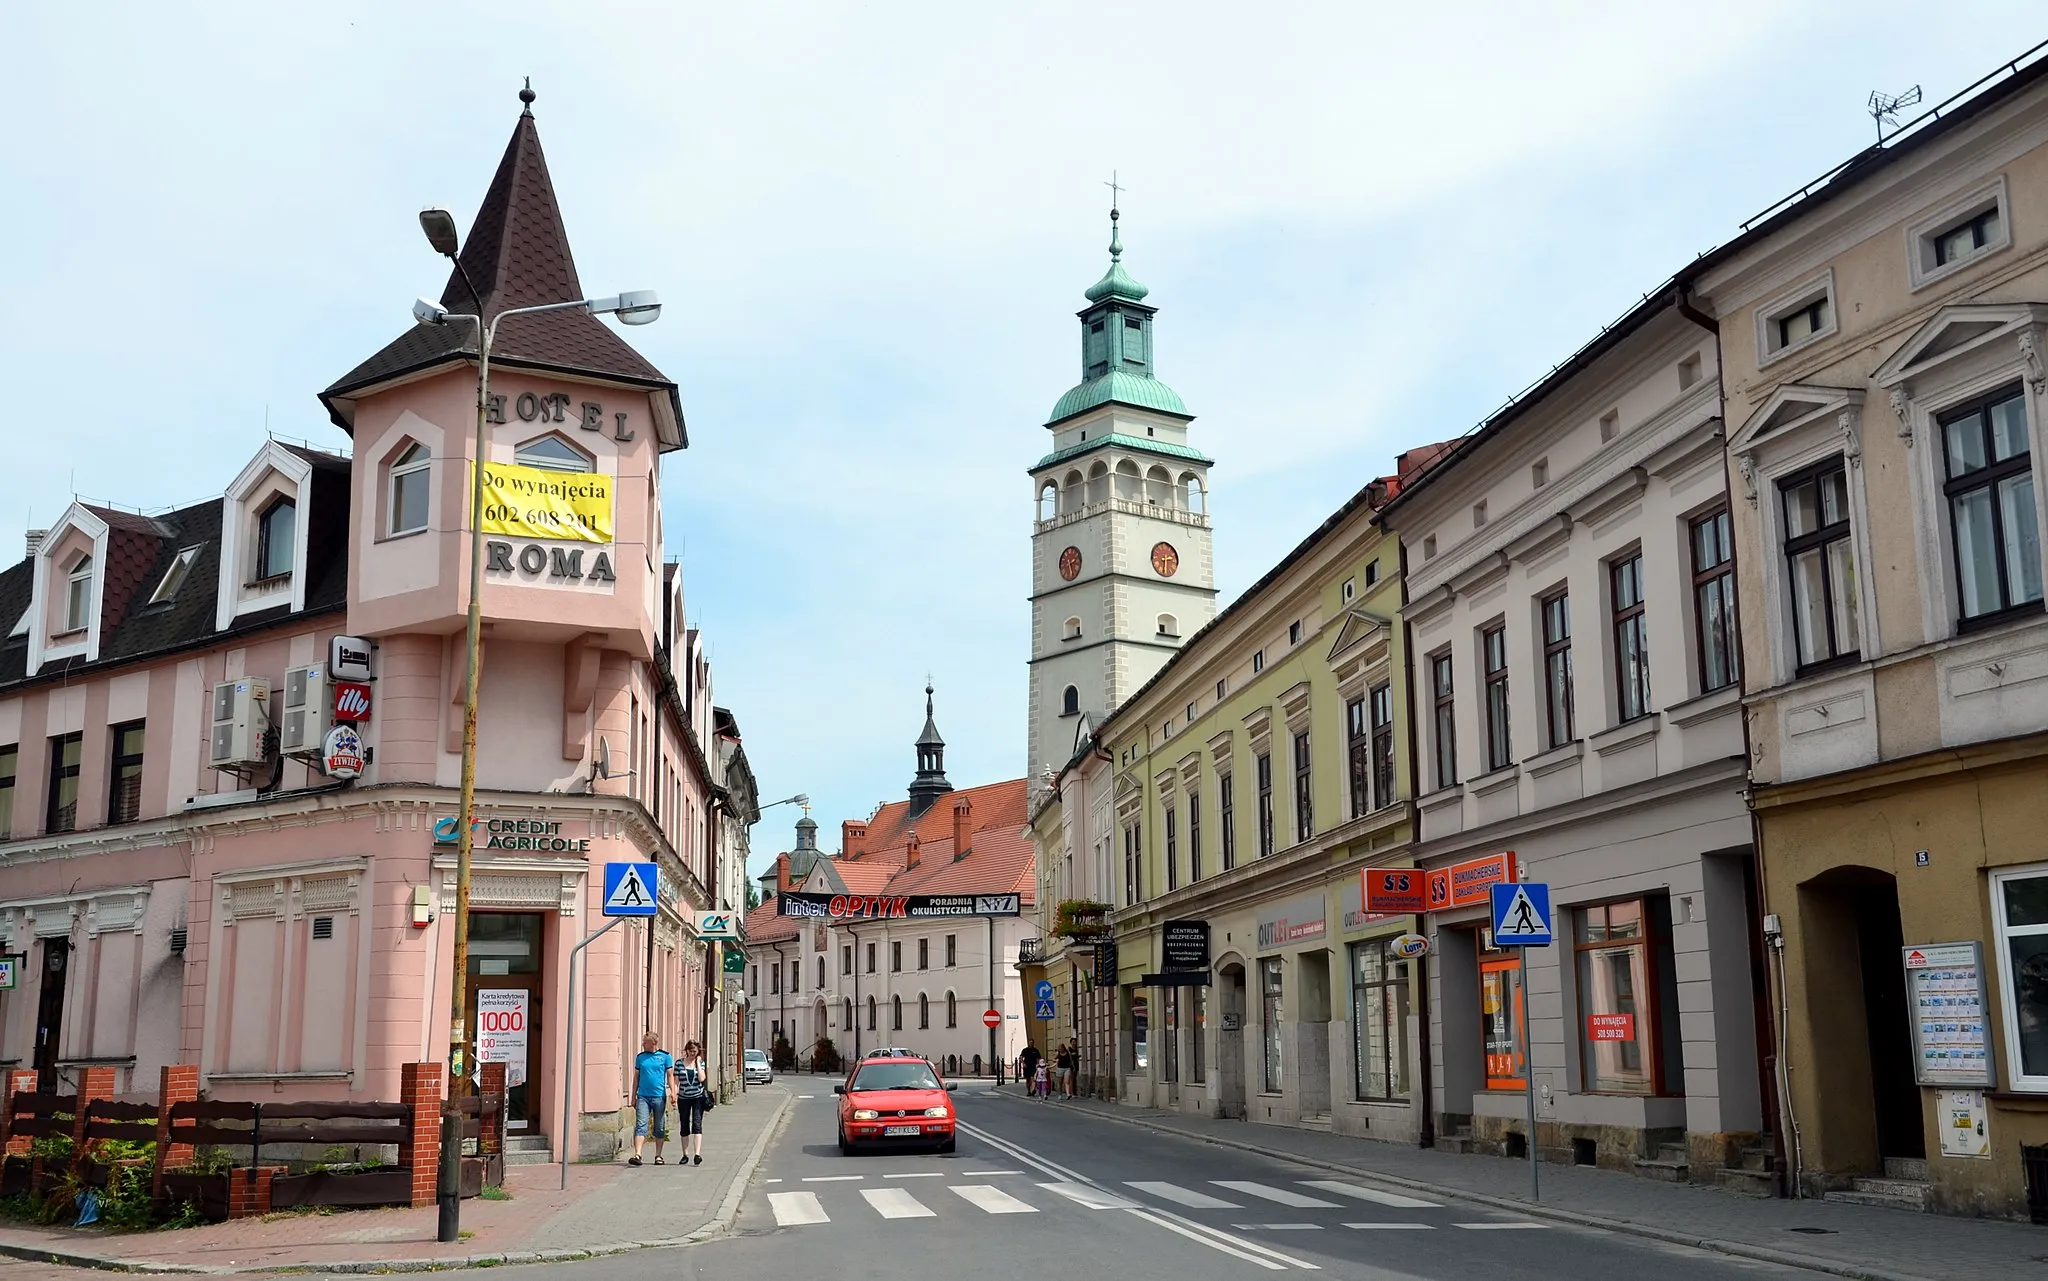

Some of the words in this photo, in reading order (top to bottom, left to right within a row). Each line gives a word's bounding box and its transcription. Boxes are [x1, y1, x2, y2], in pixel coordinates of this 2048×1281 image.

[485, 391, 635, 442] HOSTEL
[512, 479, 606, 502] wynajęcia
[485, 504, 519, 523] 602
[526, 508, 560, 527] 608
[565, 512, 597, 531] 201
[487, 540, 616, 580] ROMA
[337, 688, 369, 718] illy
[487, 818, 563, 835] CRÉDIT
[487, 835, 591, 852] AGRICOLE
[1919, 852, 1926, 862] 15
[1455, 863, 1501, 884] BUKMACHERSKIE
[1383, 873, 1411, 893] STS
[785, 899, 827, 917] inter
[829, 895, 910, 918] OPTYK
[911, 906, 973, 915] OKULISTYCZNA
[929, 898, 973, 906] PORADNIA
[1258, 919, 1288, 946] OUTLET
[1404, 942, 1423, 953] LOTTO
[1593, 1017, 1600, 1026] DO
[1601, 1016, 1627, 1027] WYNAJĘCIA
[481, 1039, 496, 1048] 100
[480, 1051, 490, 1060] 10
